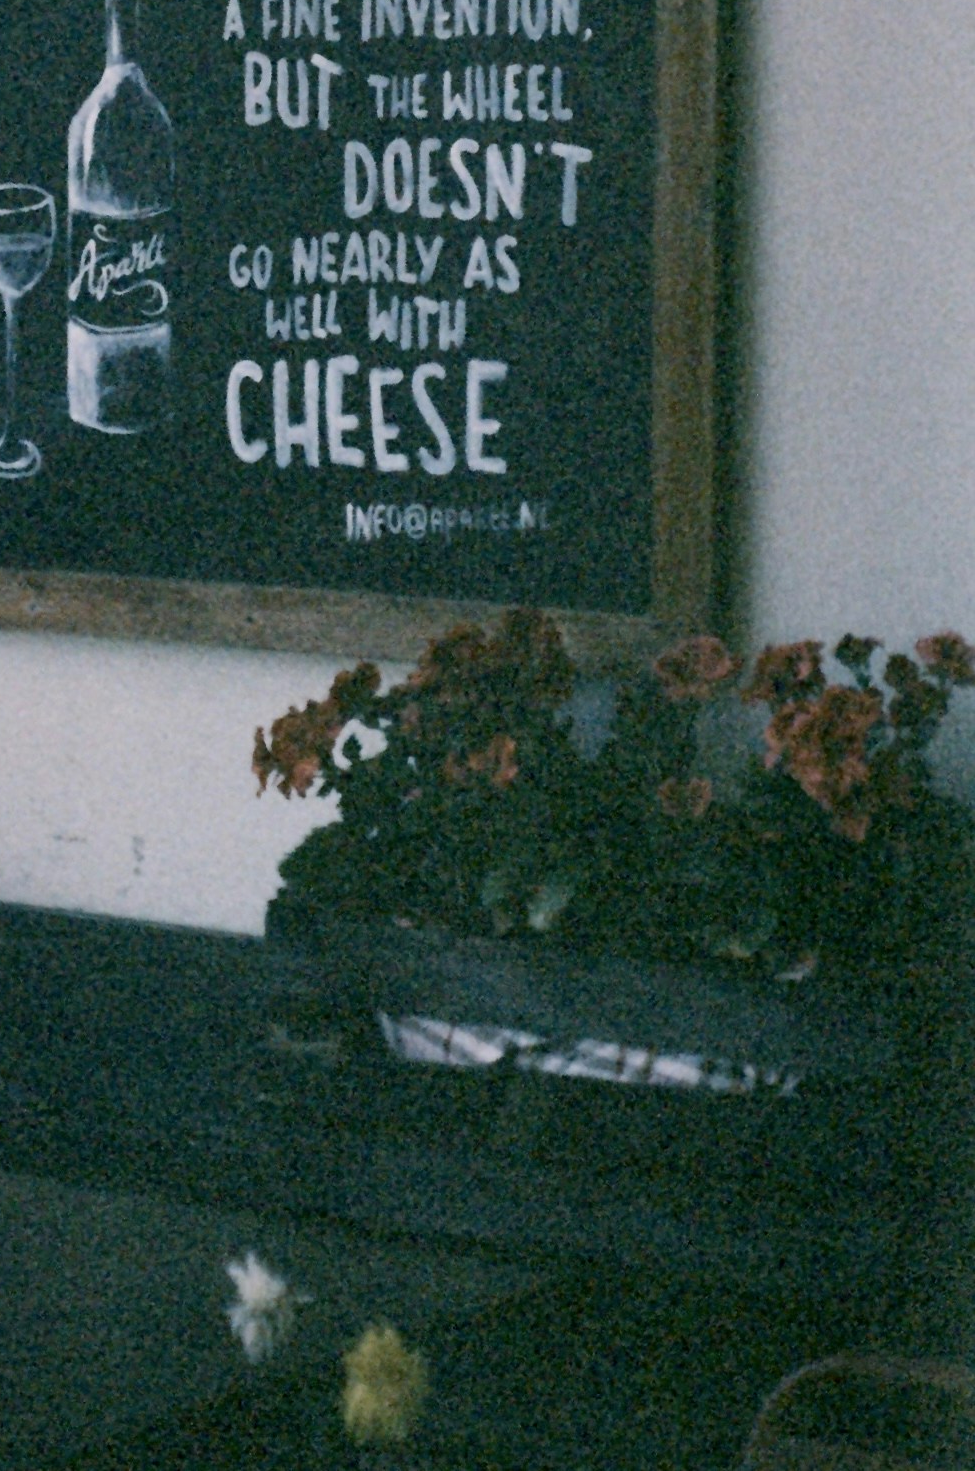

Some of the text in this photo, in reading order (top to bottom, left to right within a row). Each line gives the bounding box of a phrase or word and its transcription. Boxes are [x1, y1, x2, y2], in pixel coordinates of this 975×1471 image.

[244, 50, 573, 131] BUT THE WHEEL
[343, 137, 593, 227] DOESN'T
[229, 230, 521, 294] GO NEARLY AS
[265, 287, 467, 352] WELL WITH
[225, 354, 508, 476] CHEESE
